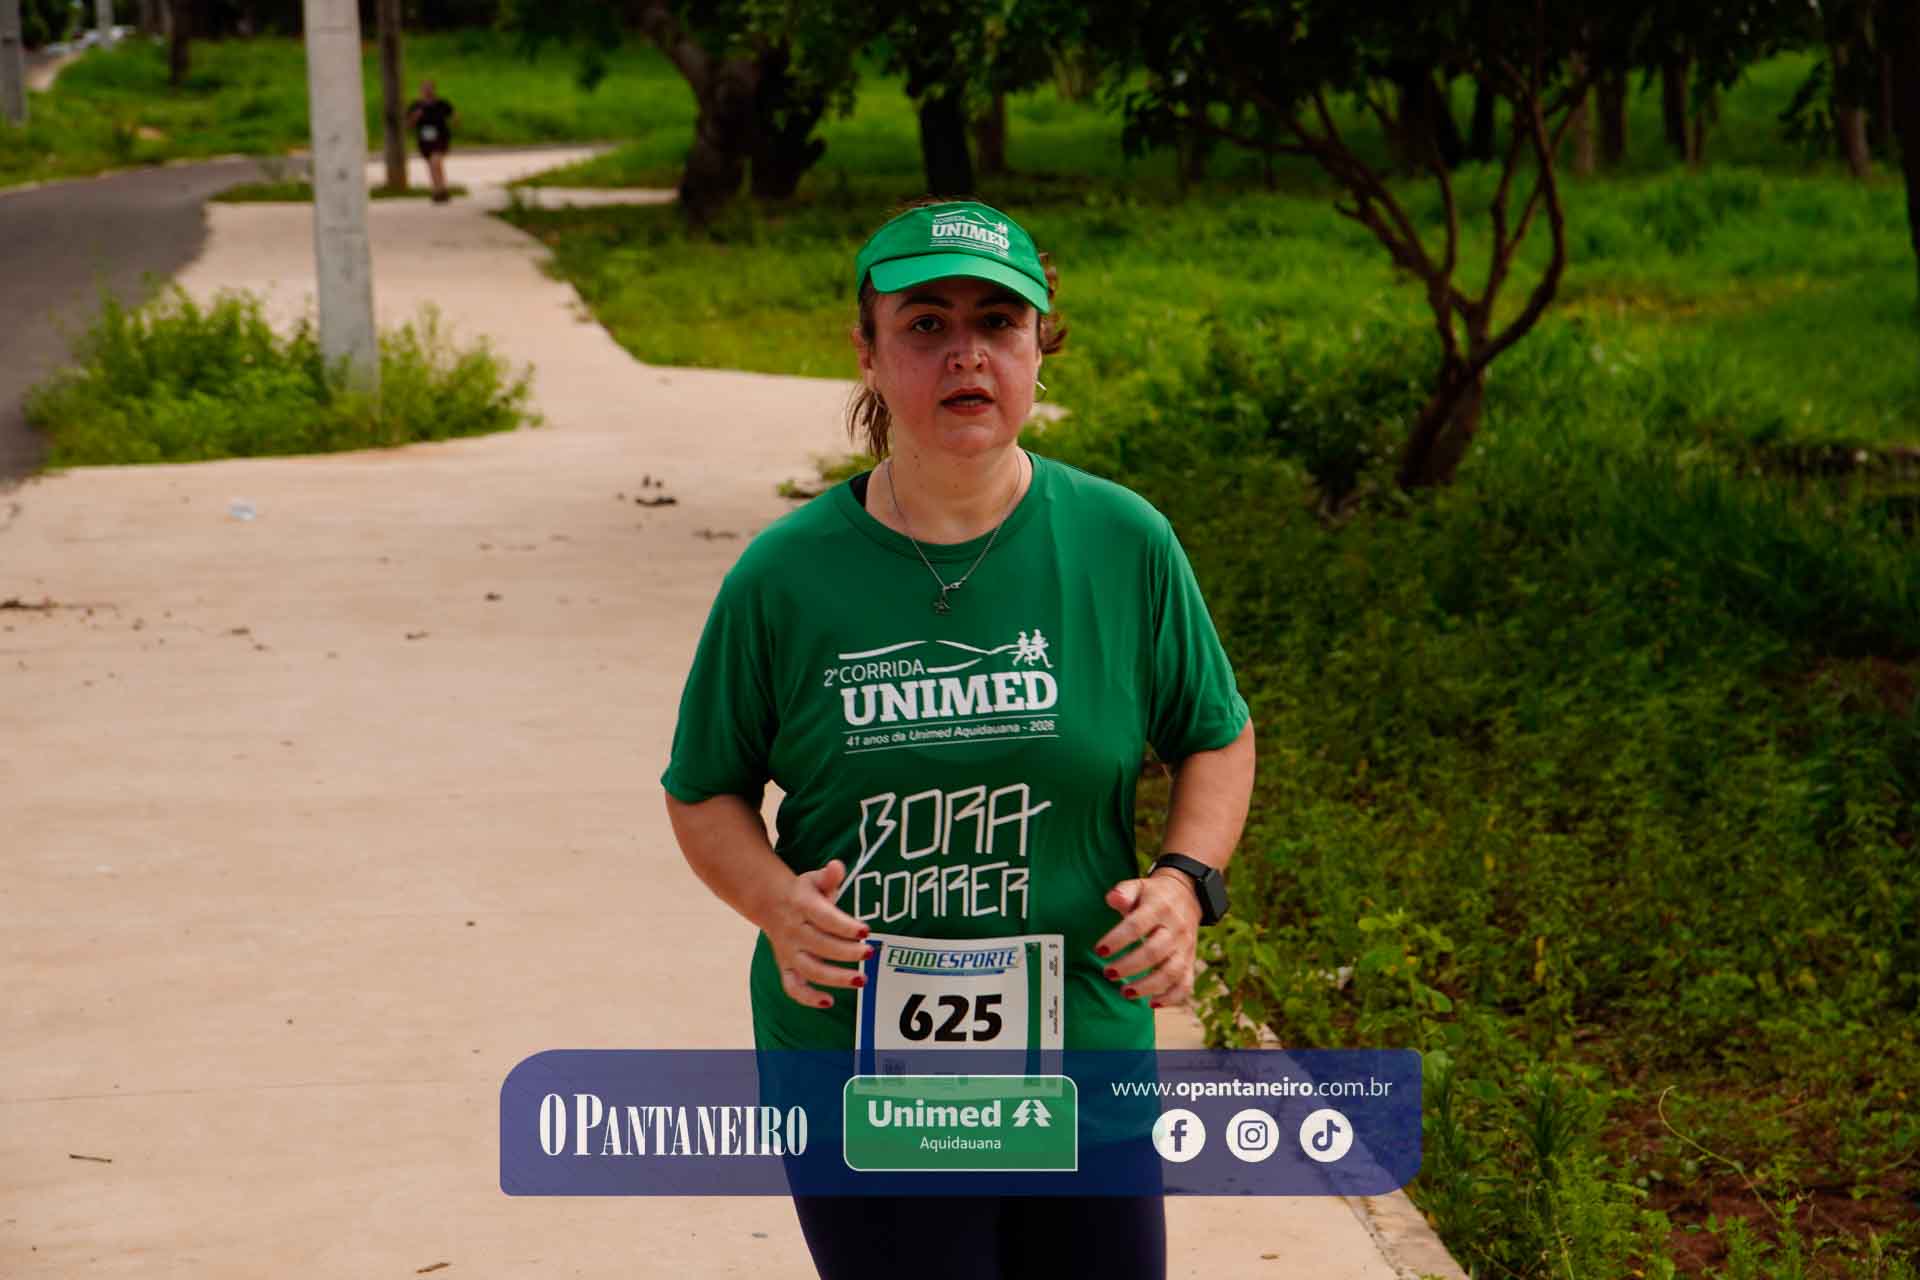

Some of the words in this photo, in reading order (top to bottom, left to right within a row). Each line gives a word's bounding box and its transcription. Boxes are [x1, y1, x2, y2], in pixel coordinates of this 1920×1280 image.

[931, 222, 1010, 250] UNIMED
[839, 658, 925, 684] CORRIDA
[840, 670, 1058, 726] UNIMED
[846, 735, 860, 747] 41
[863, 734, 890, 746] anos
[892, 732, 907, 743] da
[909, 727, 951, 742] Unimed
[953, 723, 1020, 739] Aquidauana
[838, 783, 1051, 900] BORA
[854, 861, 1029, 922] CORRER
[887, 948, 1018, 969] FUNDESPORTE
[899, 994, 1003, 1042] 625
